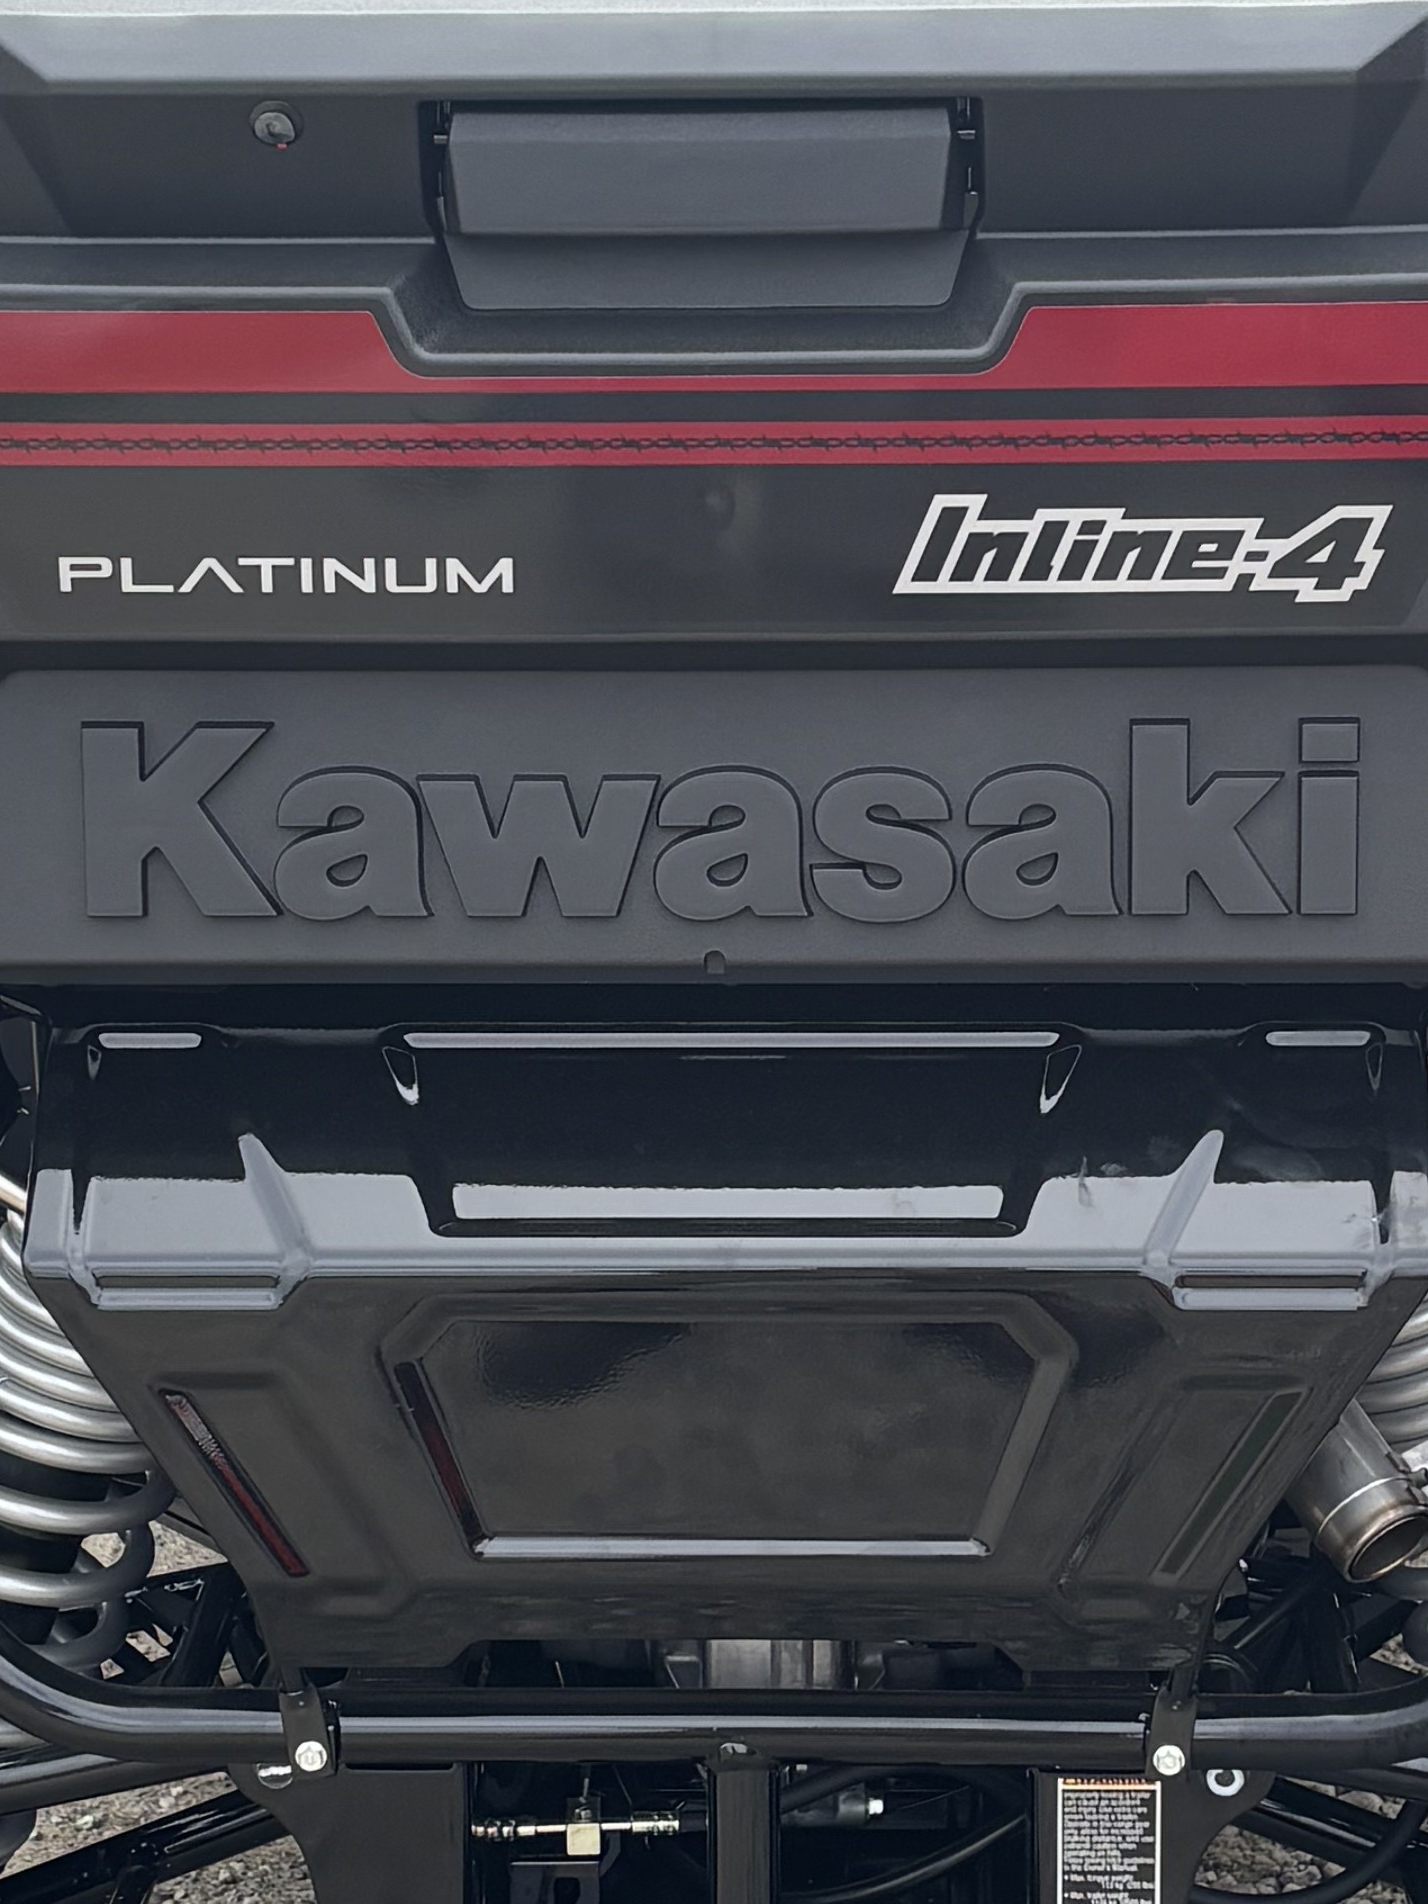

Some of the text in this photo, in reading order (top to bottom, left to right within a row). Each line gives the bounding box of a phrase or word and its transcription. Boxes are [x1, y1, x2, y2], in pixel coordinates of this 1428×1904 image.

[58, 554, 516, 595] PLATINUM
[893, 493, 1395, 604] Inline-4
[79, 714, 1364, 924] Kawasaki
